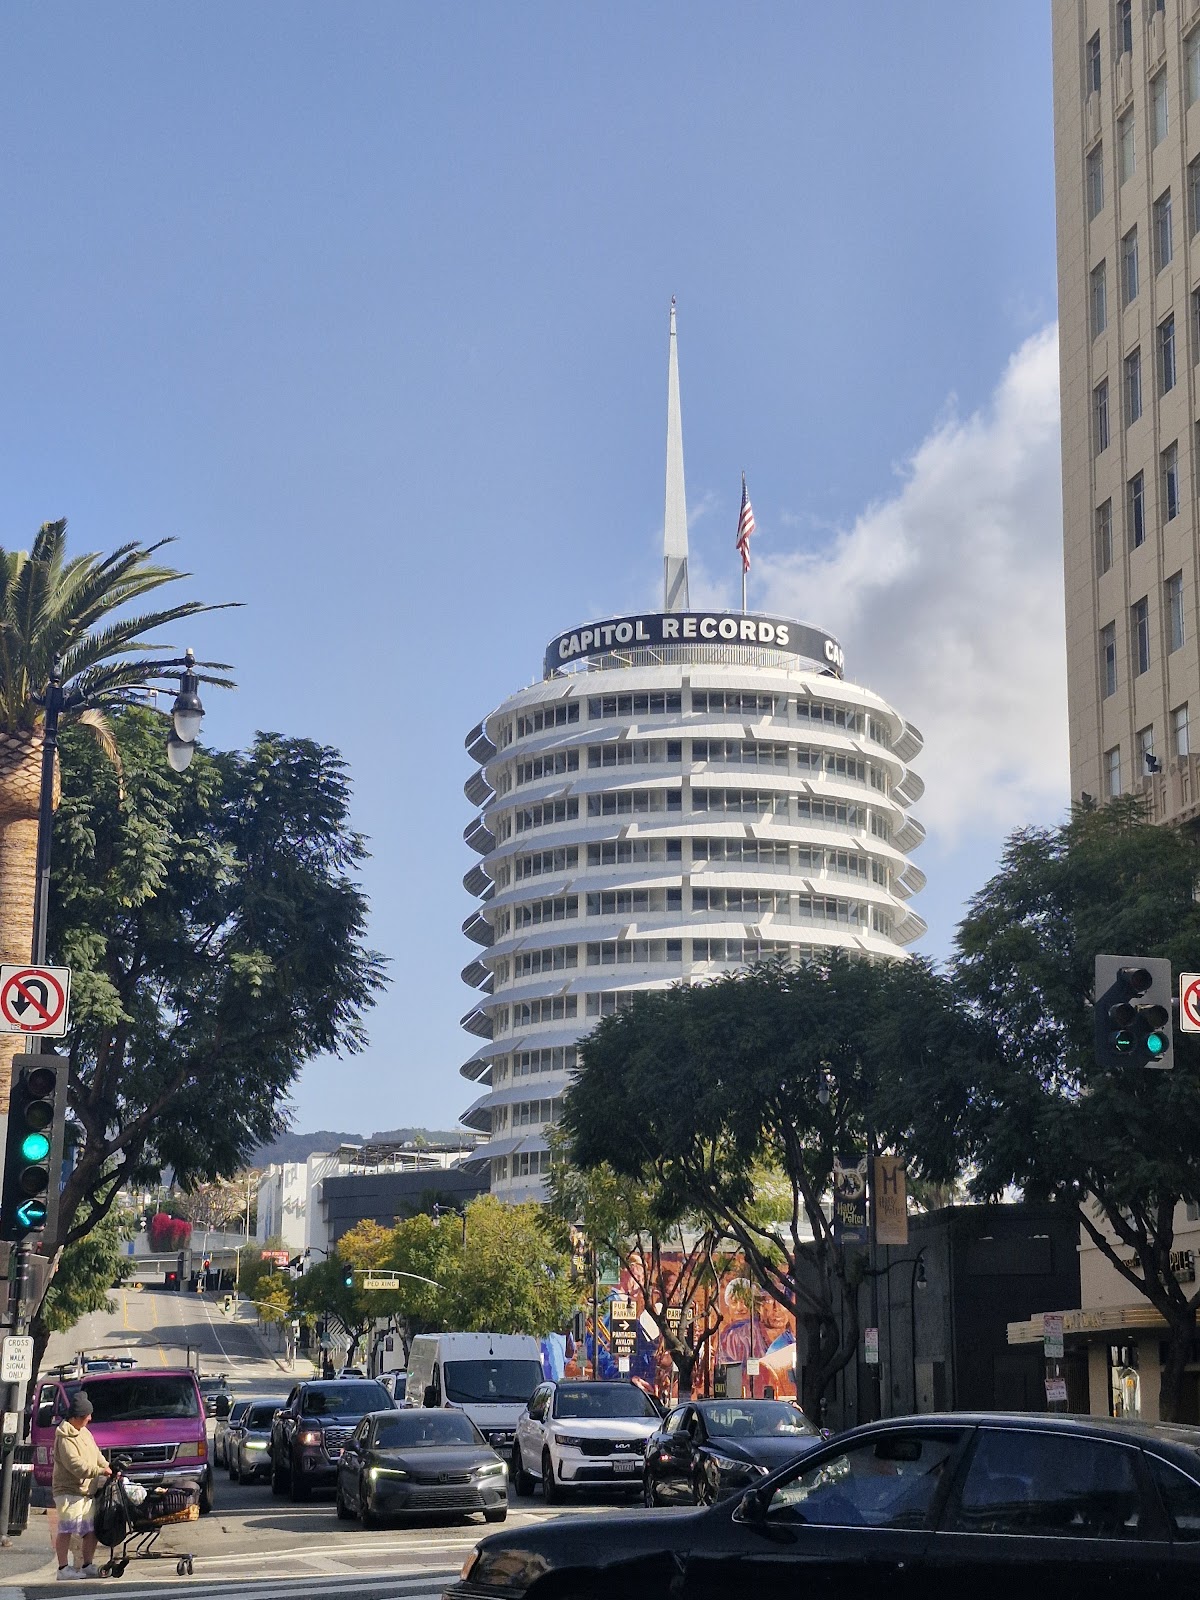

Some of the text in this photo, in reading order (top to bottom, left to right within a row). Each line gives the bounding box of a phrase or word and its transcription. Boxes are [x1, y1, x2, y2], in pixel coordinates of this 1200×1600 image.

[558, 617, 790, 659] CAPITOL RECORDS
[8, 1339, 29, 1347] CROSS
[615, 1338, 634, 1346] AVALON
[6, 1362, 27, 1370] SIGNAL
[8, 1371, 24, 1379] ONLY
